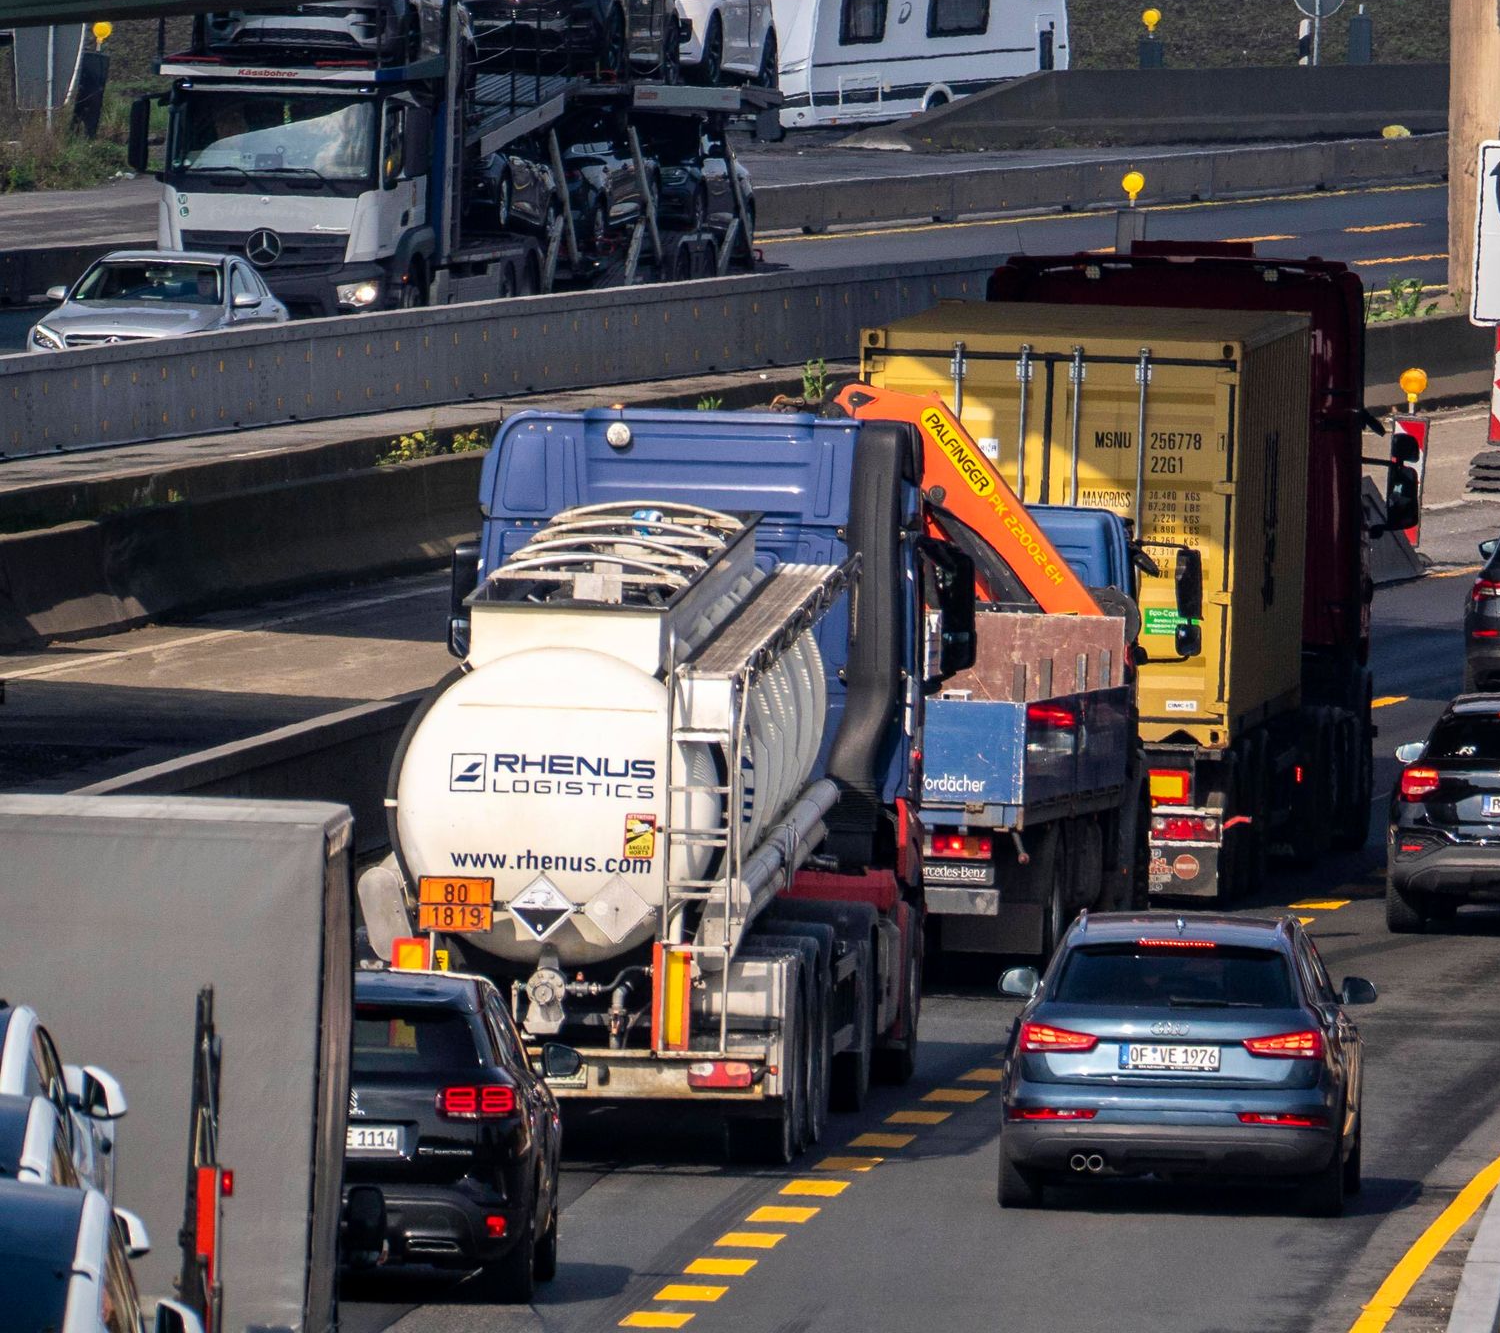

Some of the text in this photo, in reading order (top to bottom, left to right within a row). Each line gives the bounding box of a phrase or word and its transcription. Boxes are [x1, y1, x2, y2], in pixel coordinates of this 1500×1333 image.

[1094, 431, 1132, 449] MSNU
[1150, 432, 1202, 450] 256778
[925, 413, 990, 492] PALFINGER
[1150, 456, 1183, 474] 22G1
[988, 494, 1009, 517] PK
[1082, 491, 1131, 508] MAXGROSS
[494, 753, 656, 781] RHENUS
[493, 779, 655, 800] LOGISTICS
[450, 849, 653, 874] www.rhenus.com
[444, 884, 468, 903] 80
[431, 907, 482, 928] 1819
[357, 1131, 396, 1148] 1114
